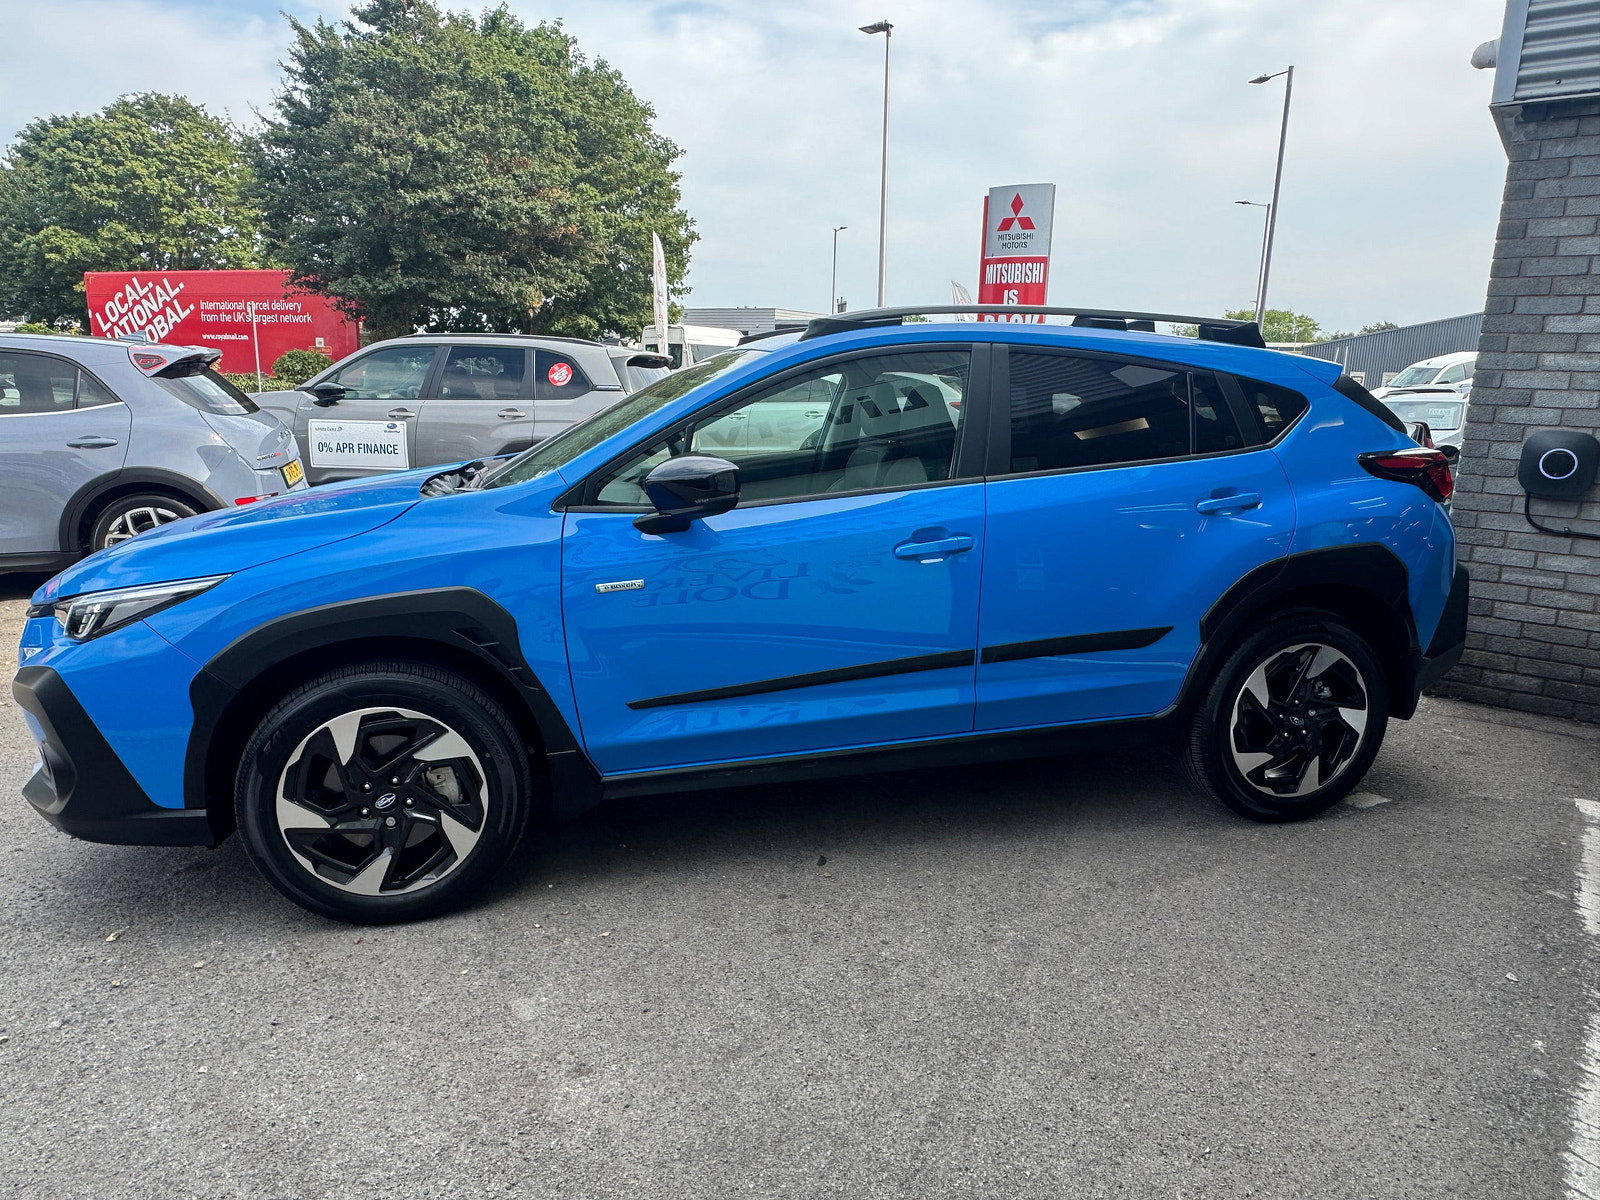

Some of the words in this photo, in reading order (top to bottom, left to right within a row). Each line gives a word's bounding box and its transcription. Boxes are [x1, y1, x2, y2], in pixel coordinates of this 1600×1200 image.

[997, 233, 1034, 242] MITSUBISHI
[1001, 241, 1028, 249] MOTORS
[985, 262, 1045, 285] MITSUBISHI
[95, 276, 153, 332] LOCAL.
[1003, 289, 1019, 305] IS
[200, 299, 246, 310] International
[247, 299, 270, 312] prcel
[271, 299, 302, 313] delivery
[144, 299, 195, 343] OBAL.
[200, 311, 219, 322] from
[220, 312, 232, 322] the
[233, 312, 252, 323] UK's
[254, 313, 278, 325] argest
[280, 312, 312, 323] network
[201, 332, 249, 342] www.royalmail.com
[317, 441, 333, 453] 0%
[336, 442, 355, 454] APR
[357, 443, 399, 455] FINANCE
